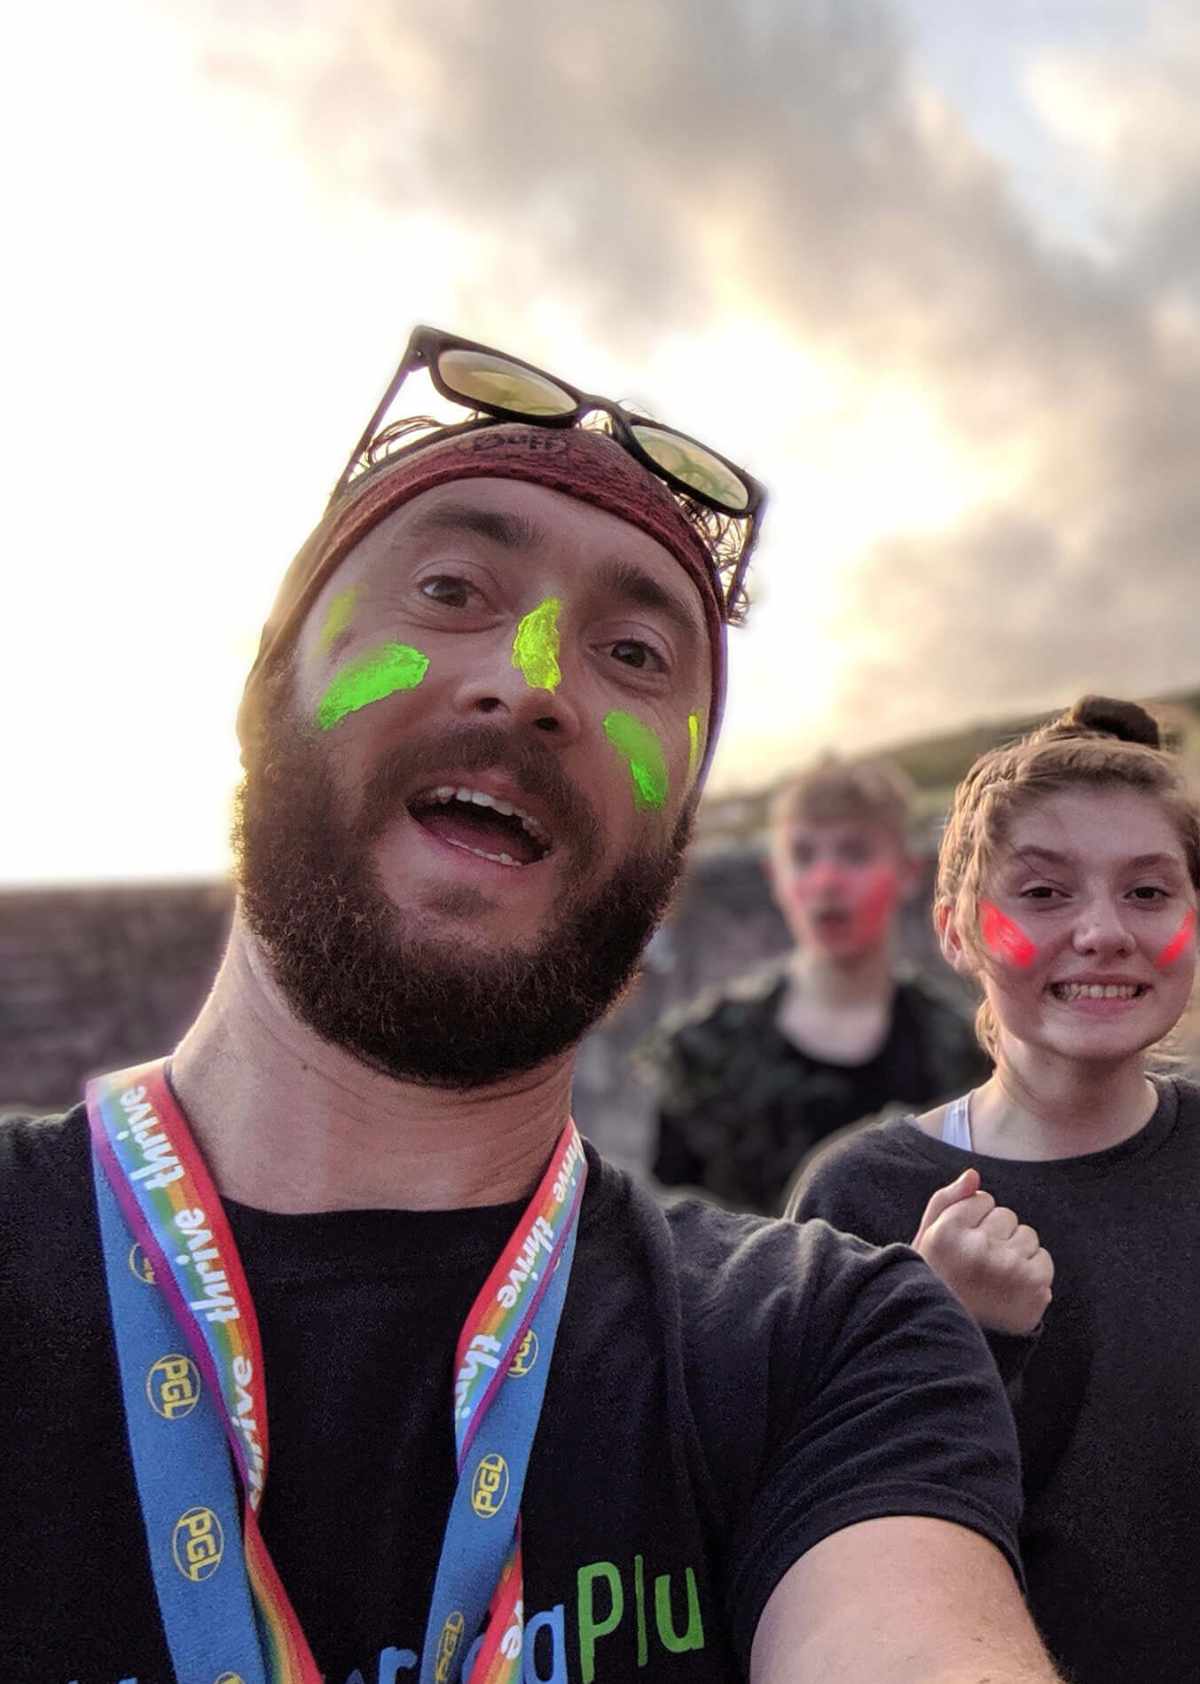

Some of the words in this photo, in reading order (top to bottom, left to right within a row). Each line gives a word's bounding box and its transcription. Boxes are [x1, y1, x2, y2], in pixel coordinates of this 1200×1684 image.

[117, 1086, 185, 1190] thrive
[175, 1208, 240, 1323] thrive
[497, 1216, 555, 1308] thrive
[154, 1358, 200, 1419] PGL
[473, 1456, 505, 1514] PGL
[178, 1510, 221, 1582] PGL
